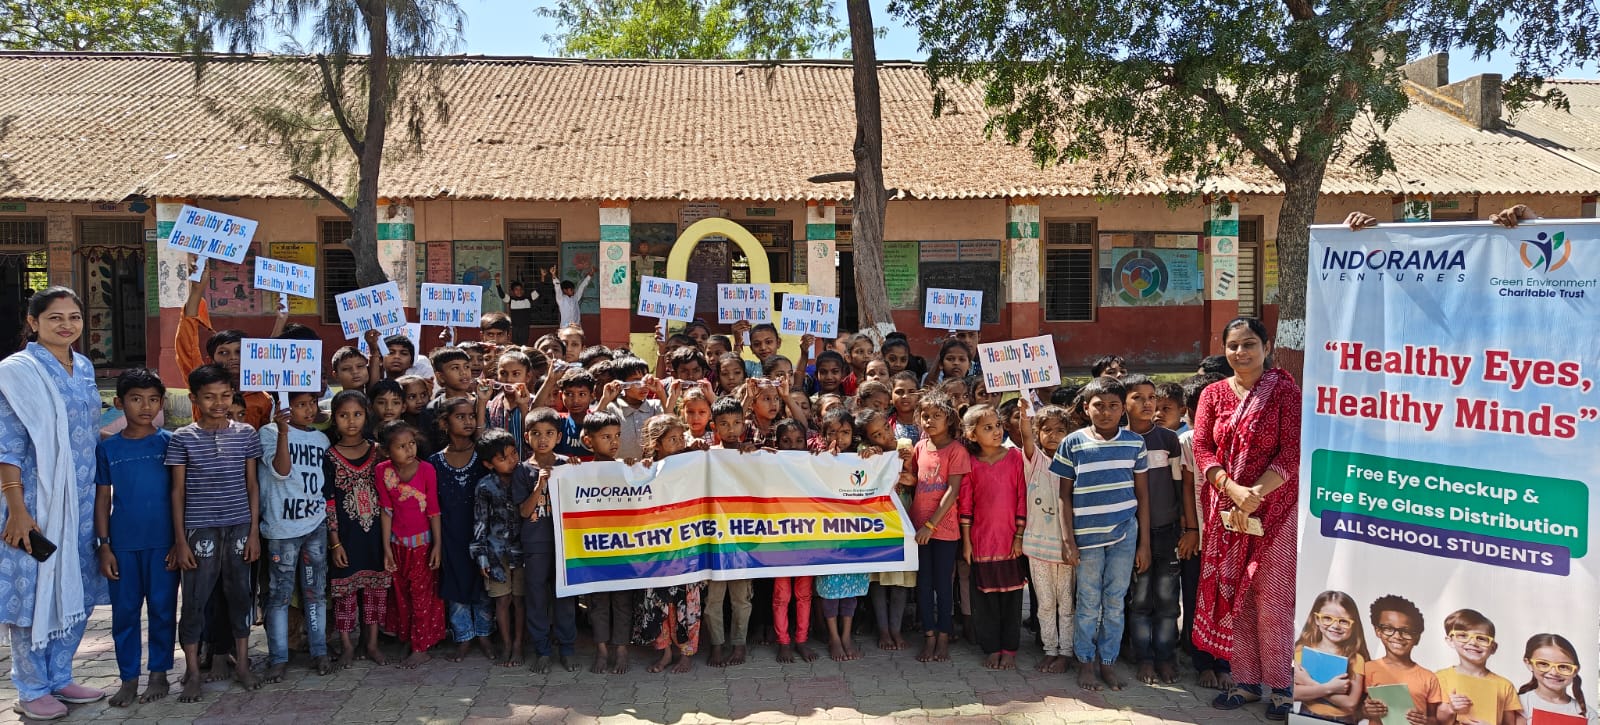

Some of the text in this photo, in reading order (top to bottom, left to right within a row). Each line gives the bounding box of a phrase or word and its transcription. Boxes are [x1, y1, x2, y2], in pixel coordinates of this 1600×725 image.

[223, 218, 247, 238] Eyes,
[171, 231, 207, 252] Healthy
[1322, 247, 1466, 270] INDORAMA
[257, 275, 284, 290] Healthy
[1322, 272, 1466, 283] VENTURES
[1490, 277, 1597, 287] Green Environment
[1499, 288, 1585, 298] Charitable Trust
[423, 308, 450, 324] Healthy
[642, 299, 666, 316] Healthy
[720, 308, 744, 321] Healthy
[342, 316, 372, 335] Healthy
[782, 317, 808, 332] Healthy
[927, 312, 952, 328] Healthy
[290, 344, 315, 363] Eyes,
[1024, 342, 1048, 358] Eyes,
[244, 370, 280, 390] Healthy
[986, 370, 1020, 389] Healthy
[1484, 350, 1591, 392] Eyes,
[1316, 386, 1443, 431] Healthy
[301, 472, 318, 494] TO
[576, 484, 652, 498] INDORAMA
[1347, 464, 1540, 504] Free Eye Checkup &
[576, 495, 654, 504] VENTURES
[1316, 487, 1579, 538] Free Eye Glass Distribution
[584, 518, 885, 551] HEALTHY EYES, HEALTHY MINDS
[1334, 518, 1554, 565] ALL SCHOOL STUDENTS
